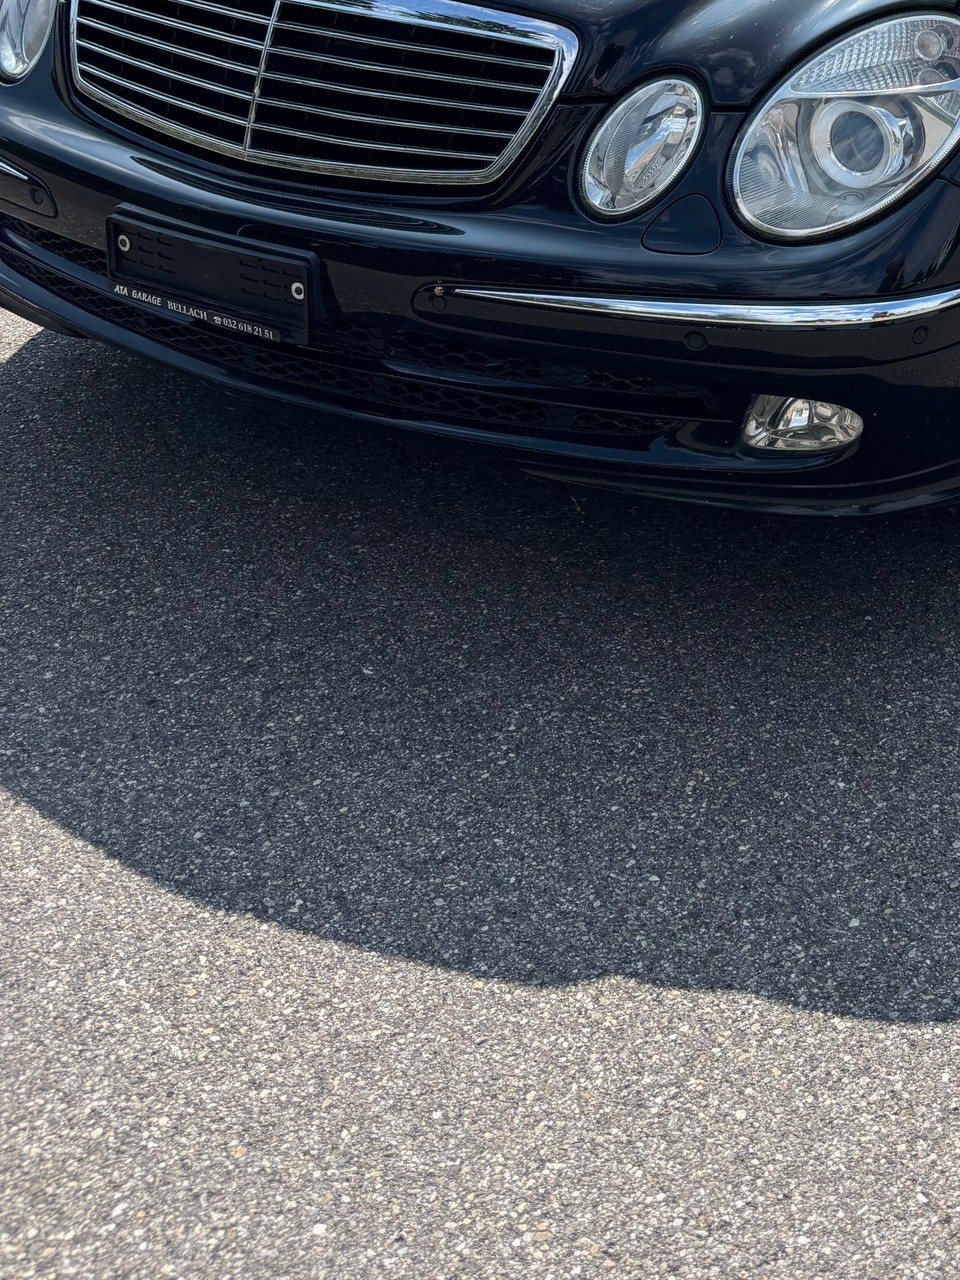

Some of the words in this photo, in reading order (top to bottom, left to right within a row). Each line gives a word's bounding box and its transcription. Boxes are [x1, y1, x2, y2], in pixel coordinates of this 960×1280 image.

[114, 284, 129, 297] ATA
[131, 290, 162, 306] GARAGE
[167, 300, 208, 321] BELLACH
[222, 317, 237, 330] 032
[238, 322, 252, 334] 618
[253, 326, 263, 337] 21
[264, 329, 274, 340] 51
